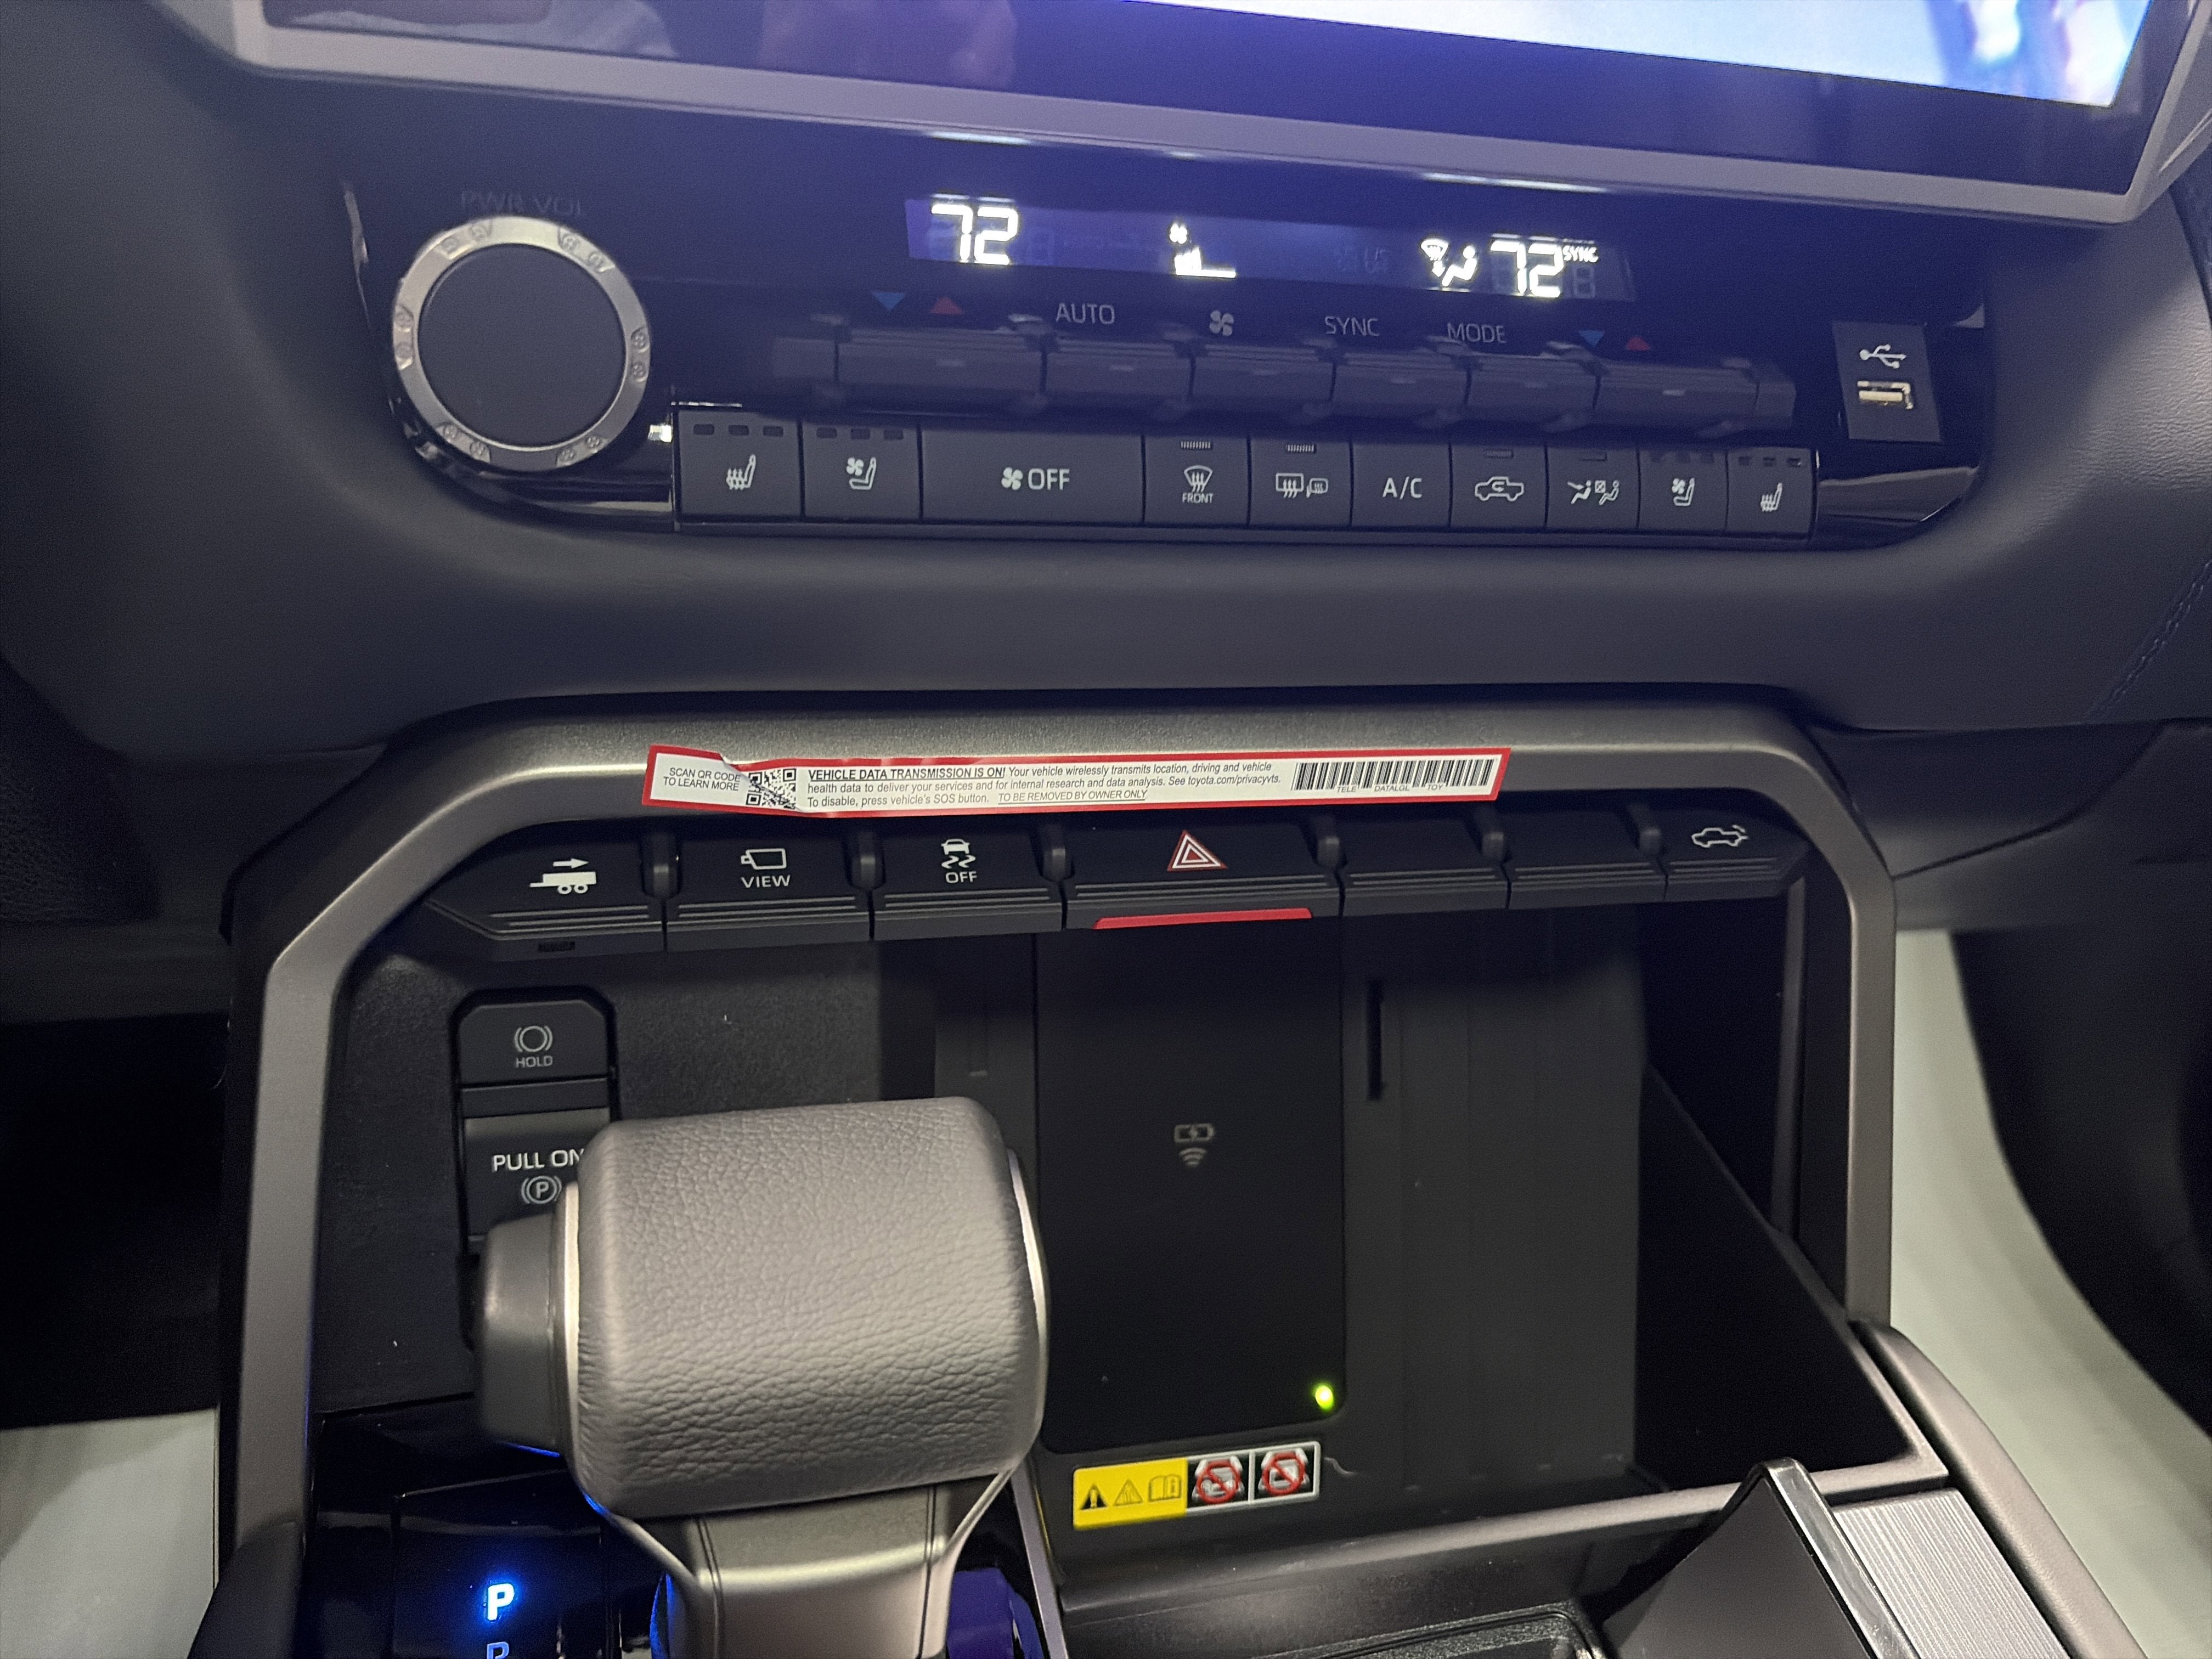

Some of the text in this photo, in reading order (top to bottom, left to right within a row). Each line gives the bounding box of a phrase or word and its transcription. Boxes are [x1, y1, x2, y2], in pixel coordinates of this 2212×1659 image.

[931, 203, 1018, 265] 72
[1563, 245, 1599, 263] SYNC
[1490, 240, 1564, 298] 72
[1056, 303, 1115, 325] AUTO
[1324, 316, 1379, 336] SYNC
[1447, 321, 1506, 343] MODE
[1028, 468, 1070, 490] OFF
[1382, 476, 1423, 500] A/C
[1182, 492, 1214, 504] FRONT
[669, 767, 741, 783] SCAN QR CODE
[808, 761, 1272, 780] VEHICLE DATA TRANSMISSION IS ON! Your vehicle wirelessly transmits location, driving and vehicle
[663, 776, 740, 791] TO LEARN MORE
[808, 774, 1281, 794] health data to deliver your services and for internal research and data analysis. See toyota.com/privacyvts.
[808, 789, 1148, 808] To disable, press vehicle's SOS button. TO BE REMOVED BY OWNER ONLY
[741, 874, 791, 888] VIEW
[945, 871, 977, 883] OFF
[516, 1056, 553, 1068] HOLD
[493, 1152, 545, 1171] PULL
[487, 1583, 515, 1621] P
